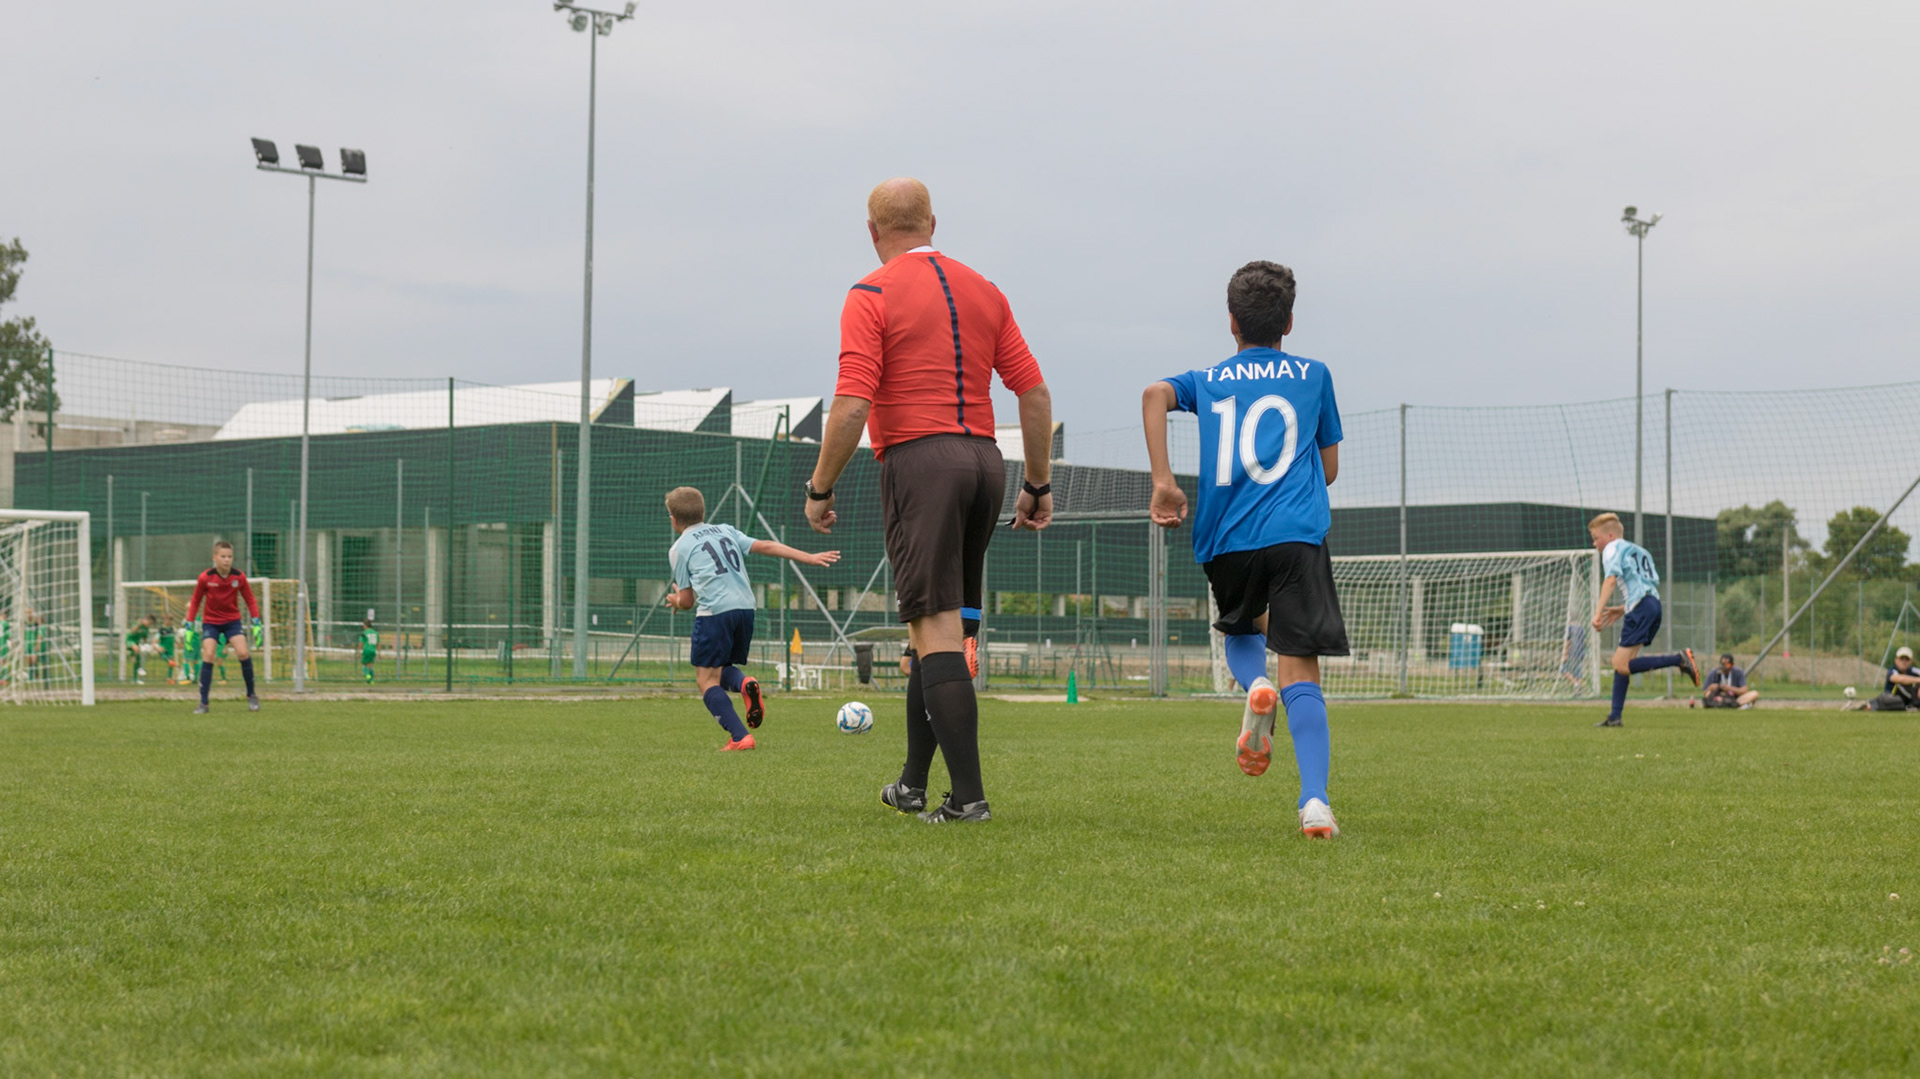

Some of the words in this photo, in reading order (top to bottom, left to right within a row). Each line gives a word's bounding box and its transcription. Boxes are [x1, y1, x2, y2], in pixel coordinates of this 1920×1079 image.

[1203, 360, 1310, 382] TANMAY
[1211, 394, 1298, 486] 10
[701, 537, 741, 575] 16
